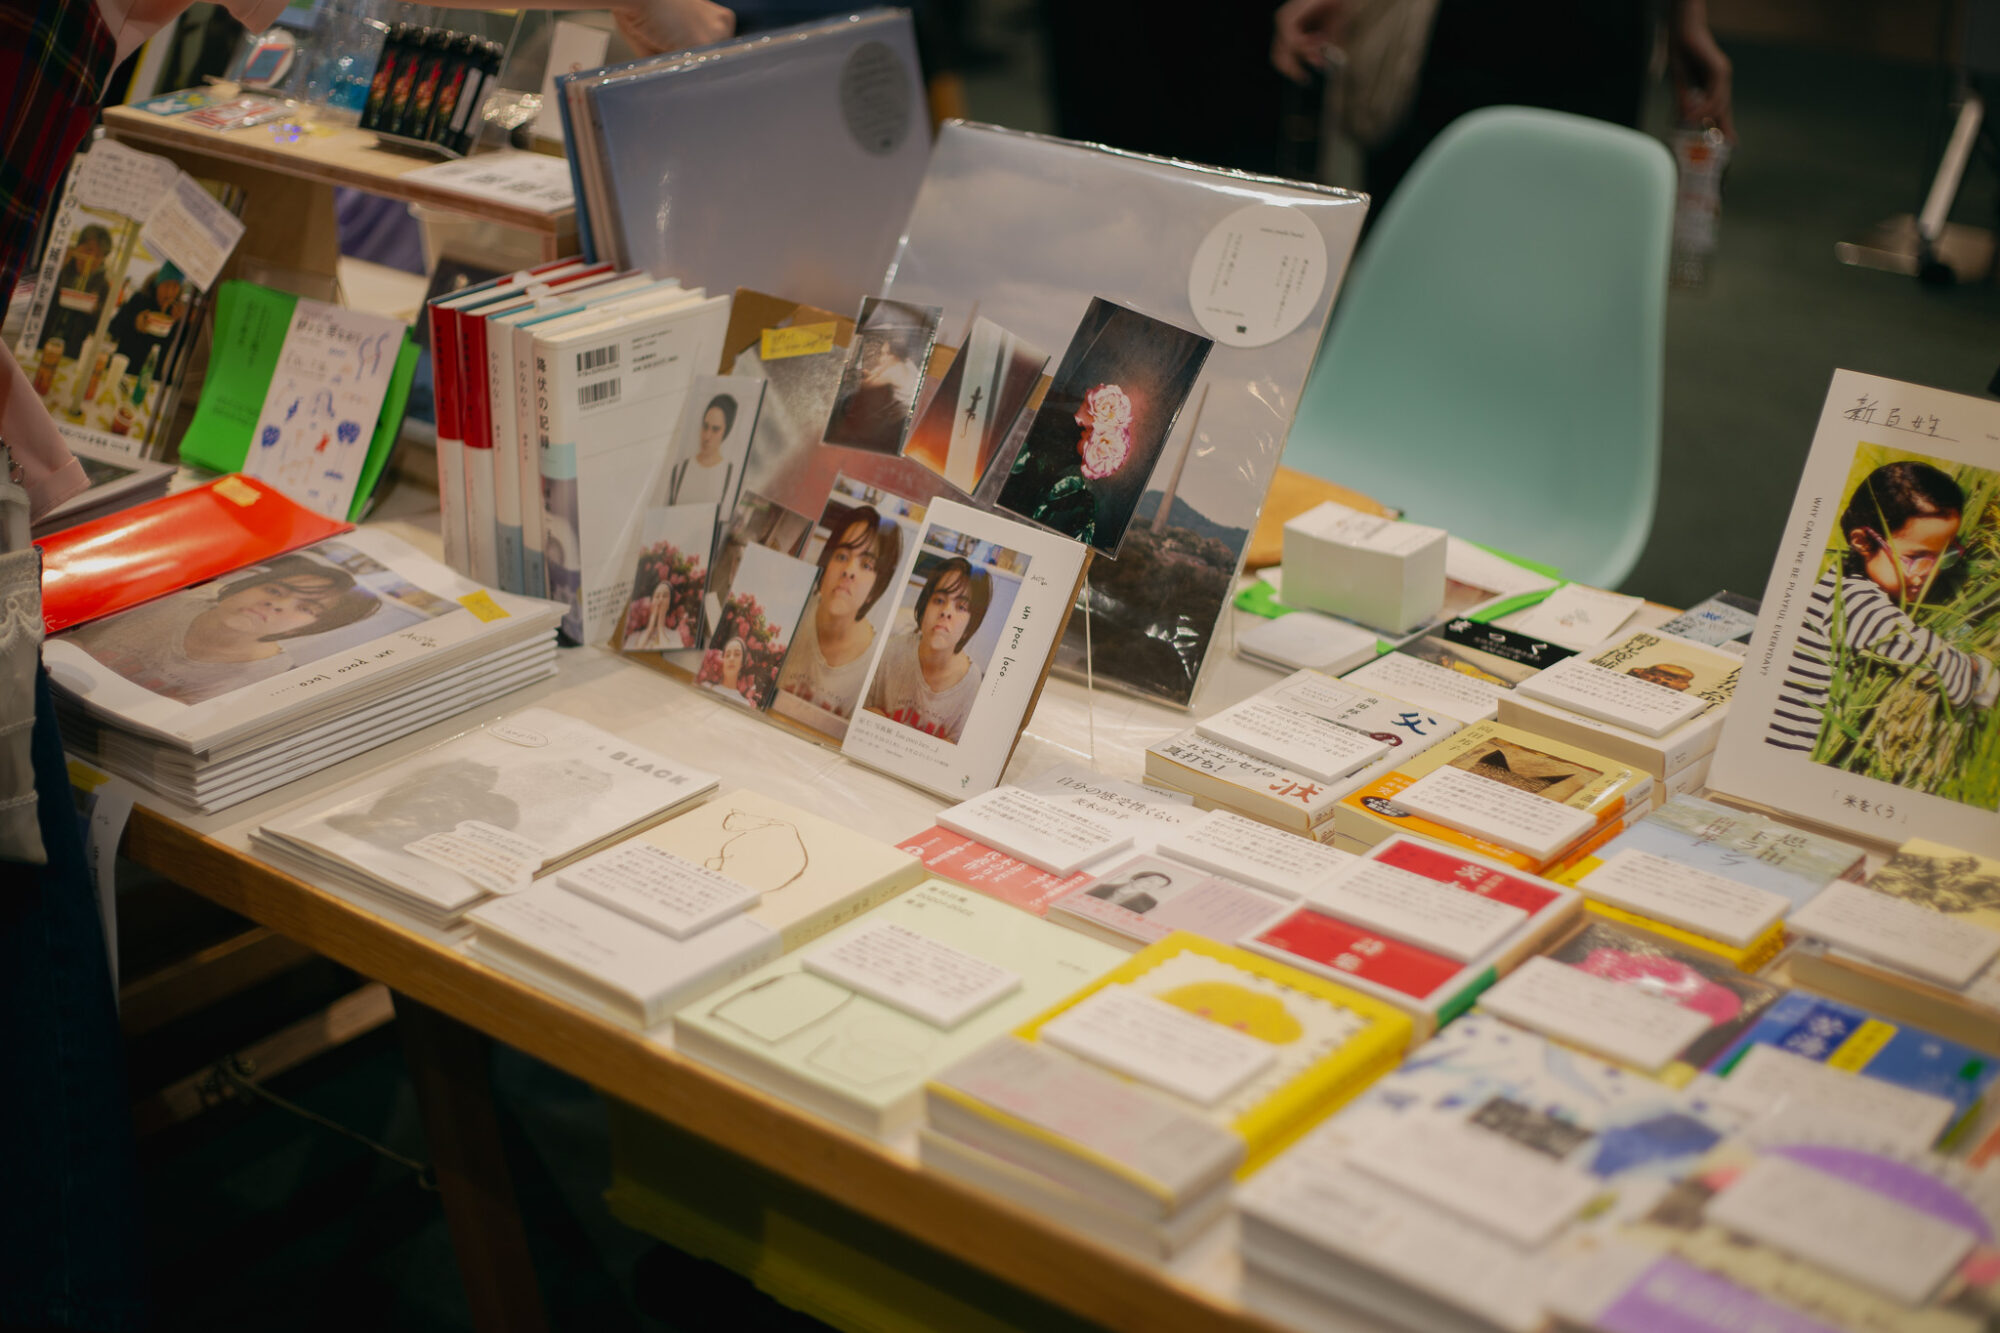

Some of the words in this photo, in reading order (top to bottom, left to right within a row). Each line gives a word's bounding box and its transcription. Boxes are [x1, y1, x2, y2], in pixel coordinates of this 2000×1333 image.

[1809, 497, 1823, 519] WHY
[1795, 550, 1806, 564] WE
[1790, 566, 1801, 580] BE
[1022, 605, 1032, 620] un
[1776, 581, 1796, 622] PLAYFUL
[1011, 626, 1025, 650] poco
[375, 649, 395, 660] un
[338, 658, 370, 674] poco
[608, 751, 690, 785] BLACK
[1176, 737, 1276, 778] これぞエッセイの
[1056, 776, 1180, 823] 自分の感受性くらい
